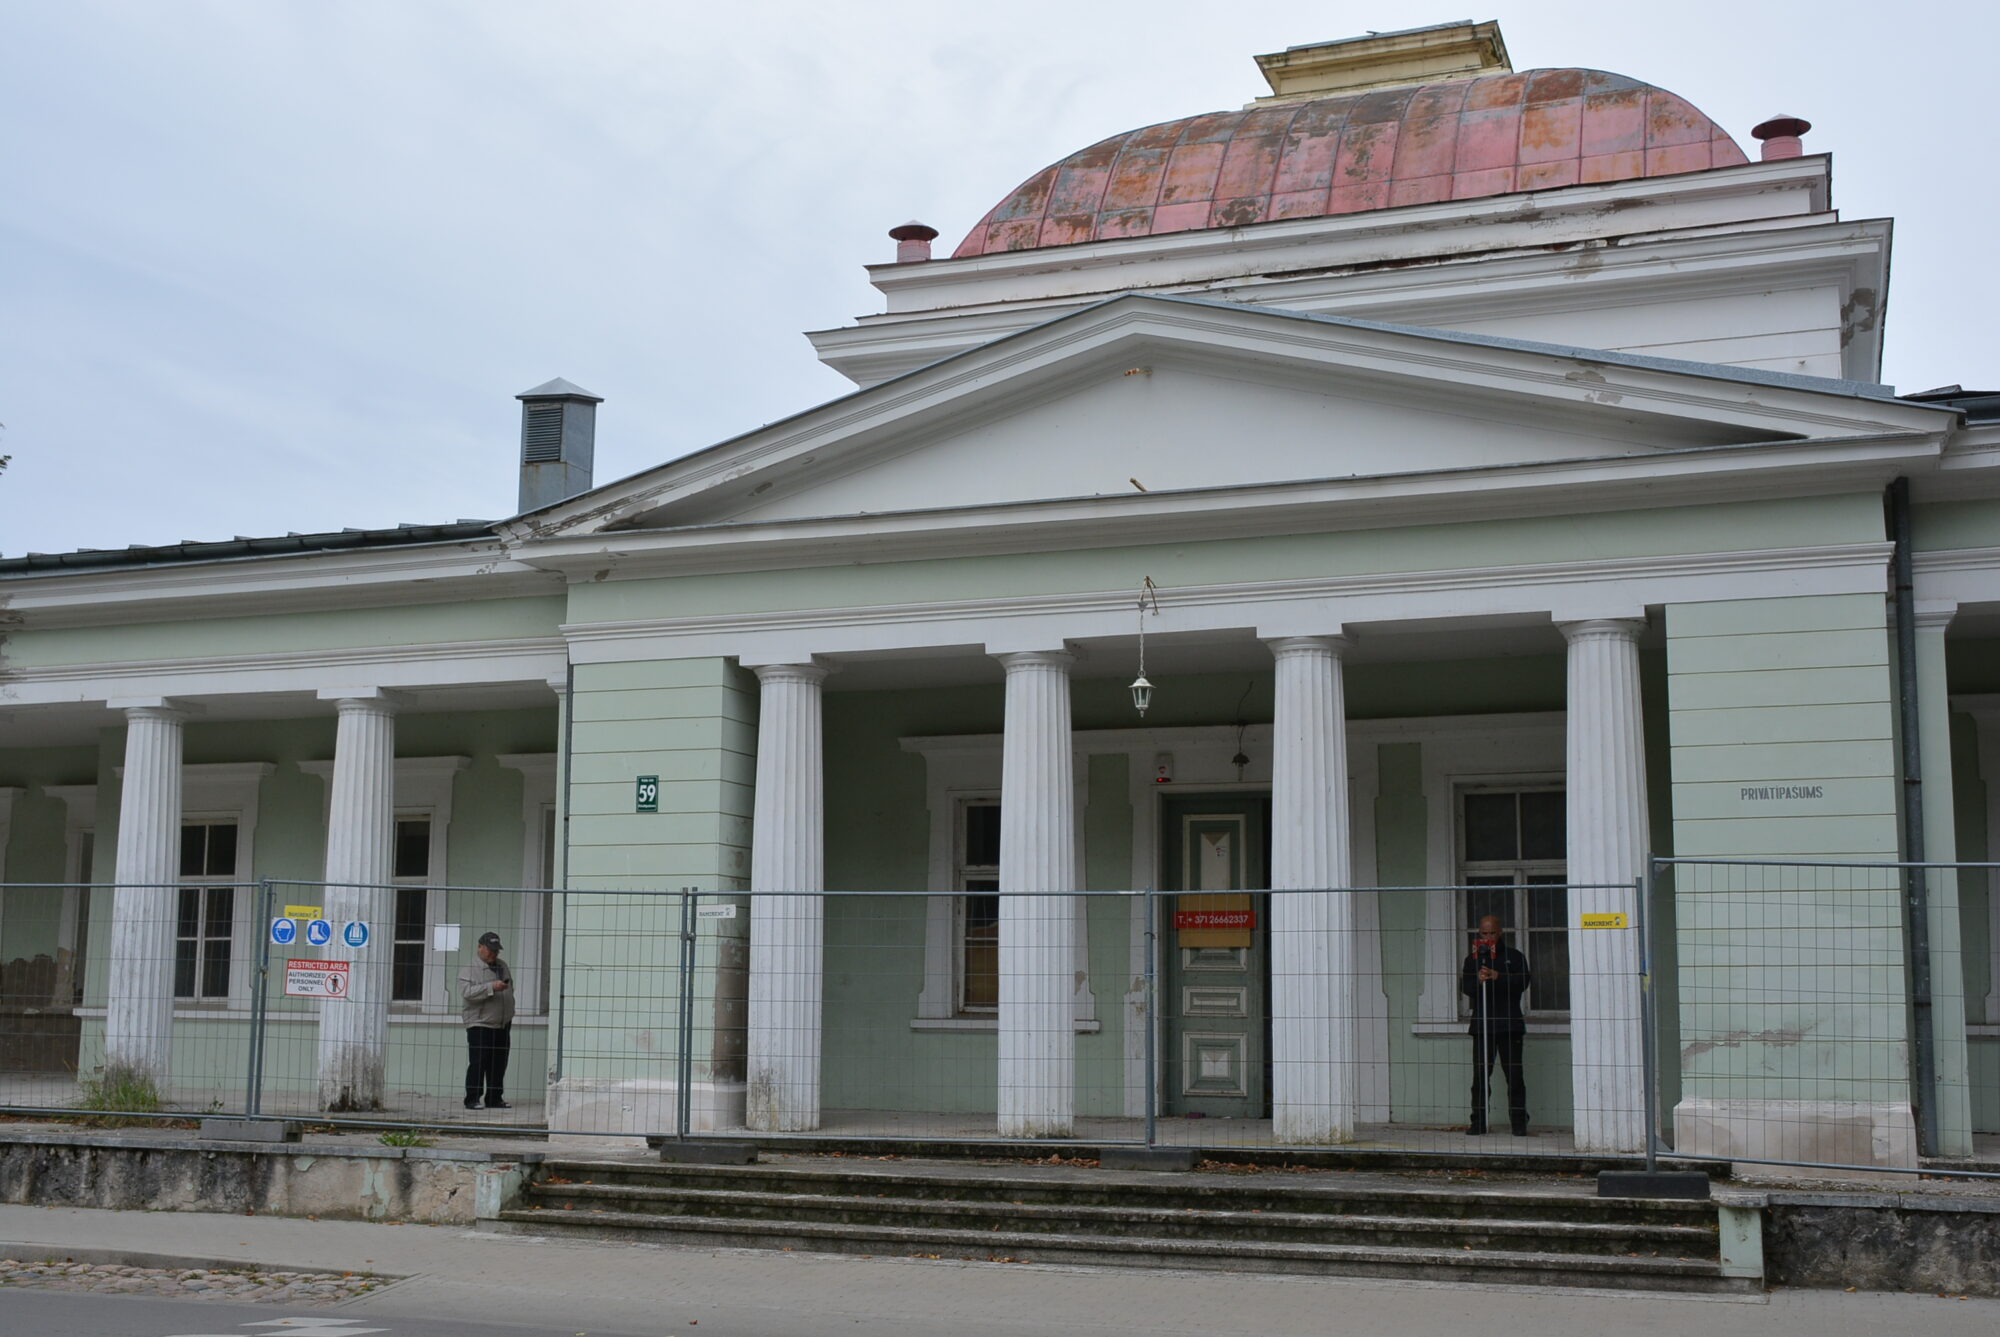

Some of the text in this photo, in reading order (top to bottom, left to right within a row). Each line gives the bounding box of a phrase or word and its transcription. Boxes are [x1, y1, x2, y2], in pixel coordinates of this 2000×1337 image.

[638, 784, 656, 803] 59
[288, 961, 348, 971] RESTRICTED AREA
